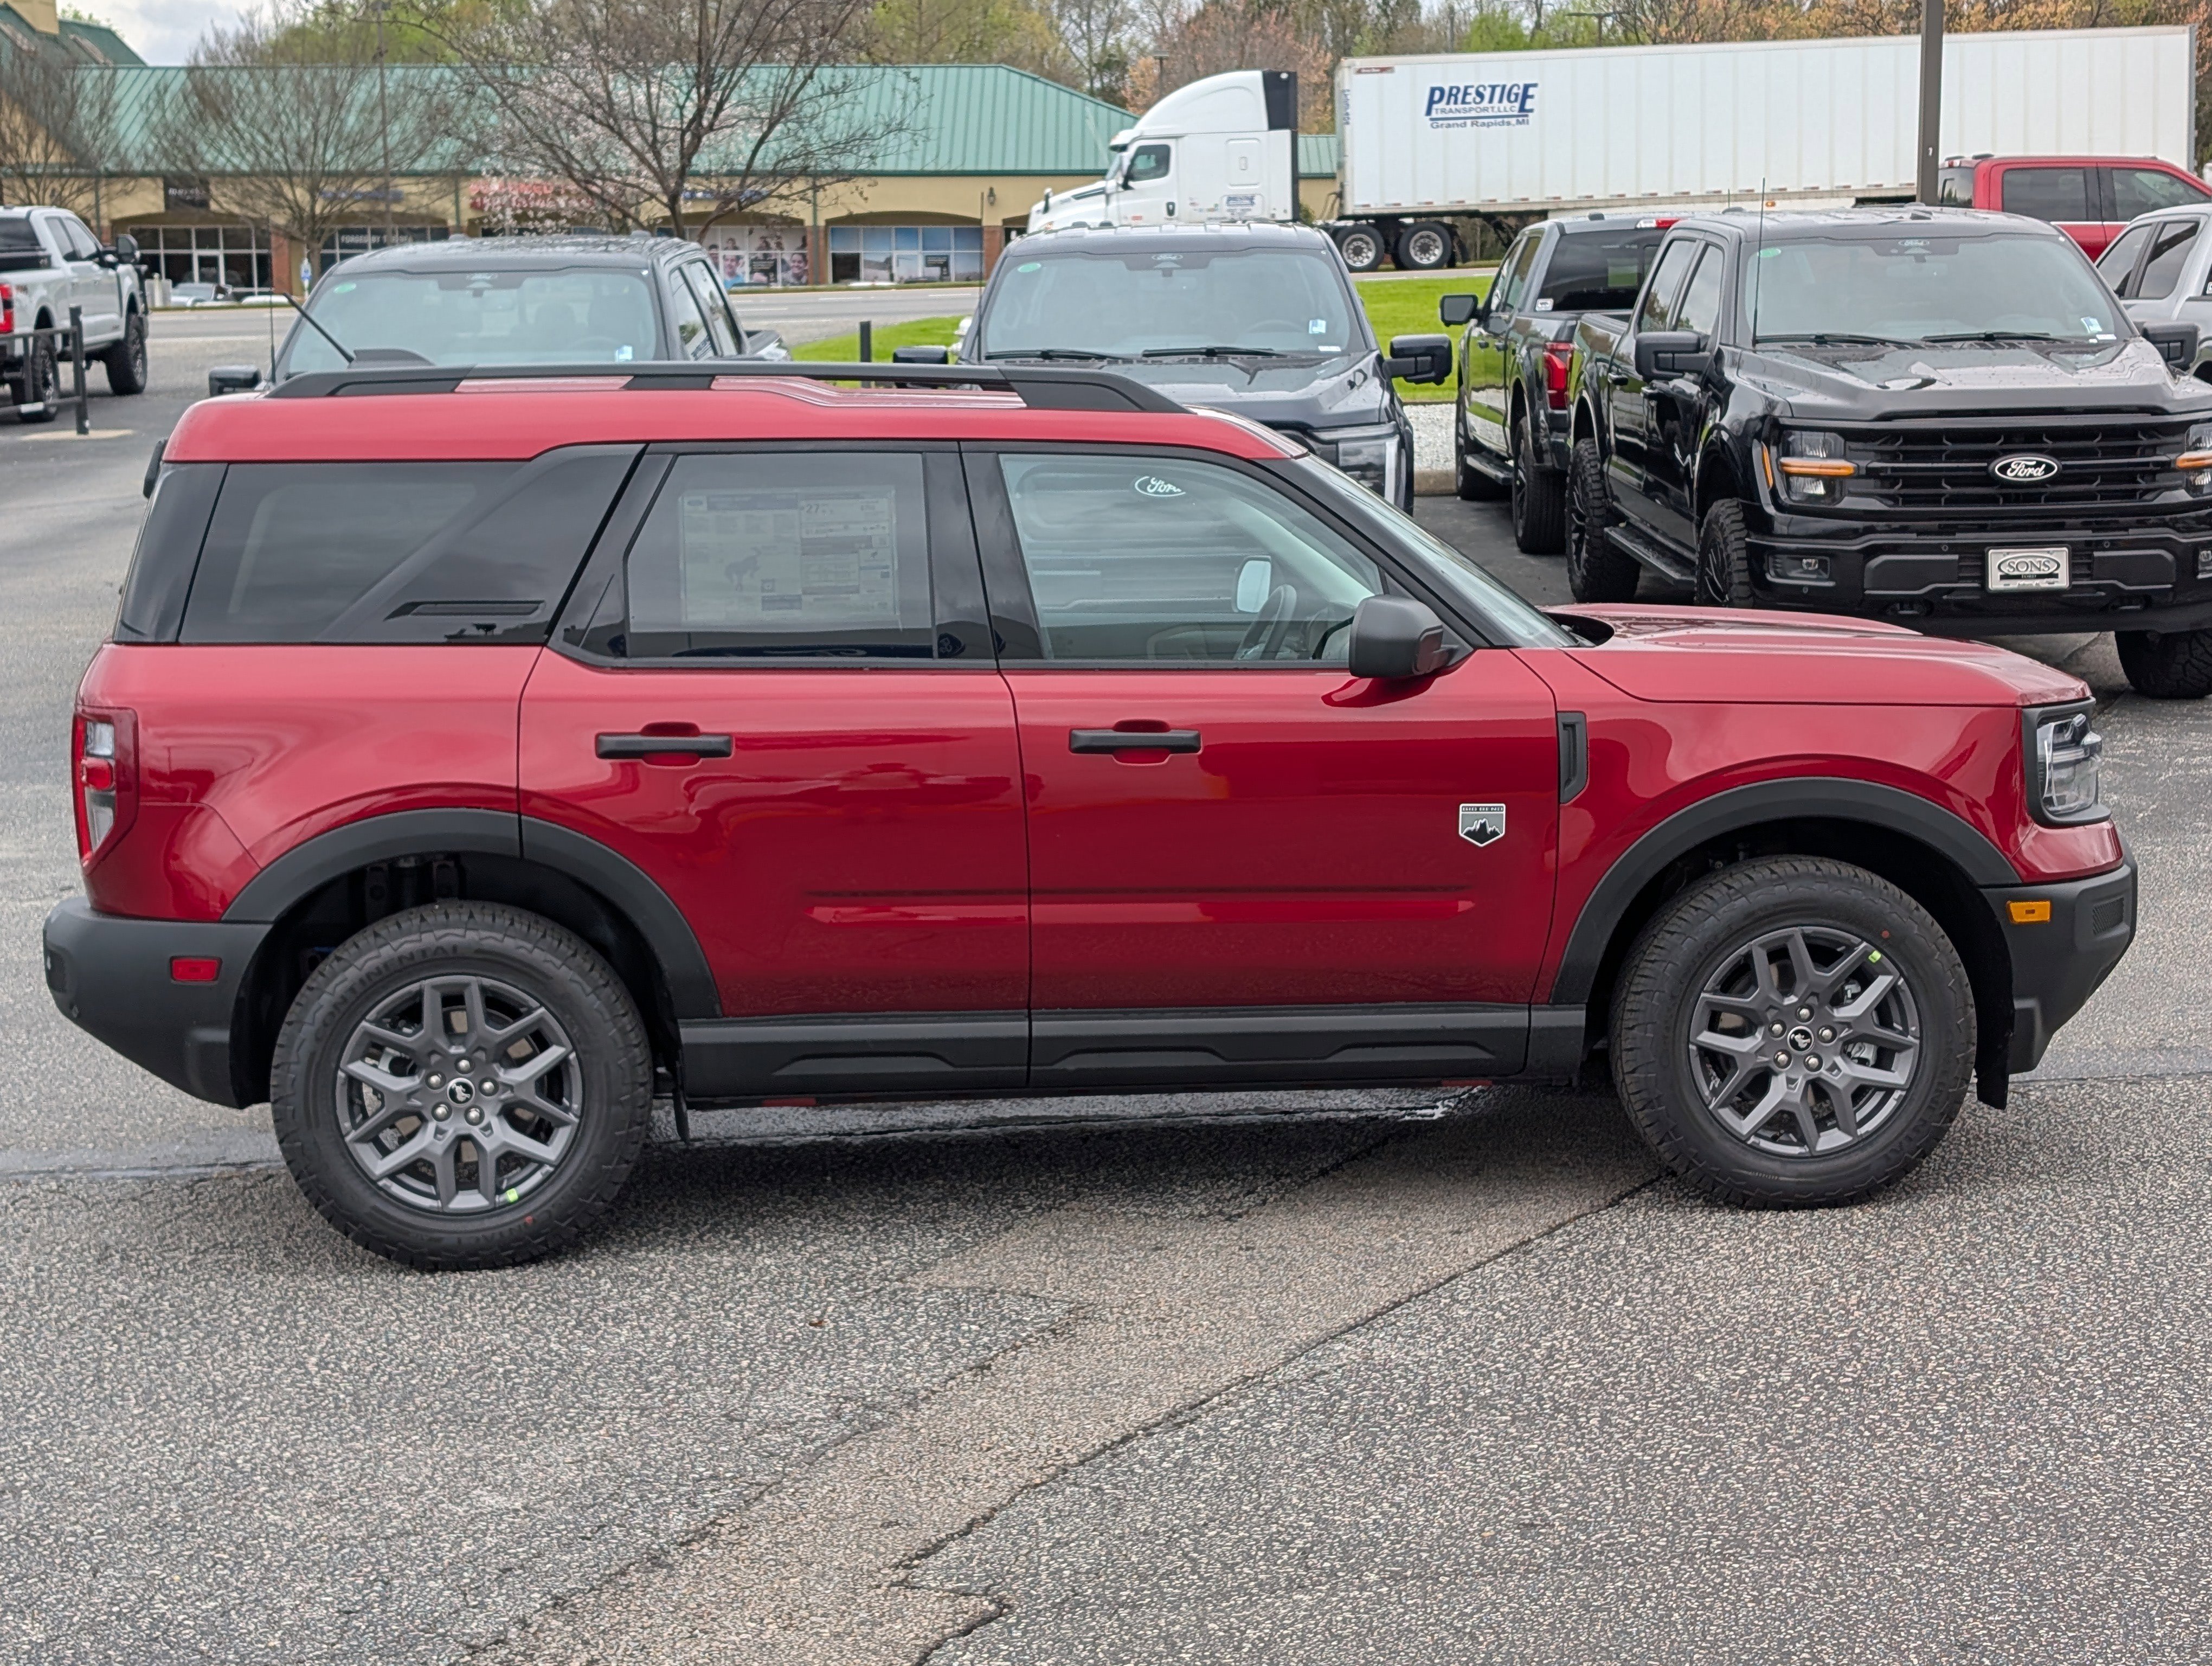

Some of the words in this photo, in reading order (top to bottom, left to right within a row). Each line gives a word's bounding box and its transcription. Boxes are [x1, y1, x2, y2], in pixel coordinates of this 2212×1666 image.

[1425, 83, 1539, 116] PRESTIGE
[2007, 460, 2046, 477] Ford
[2007, 559, 2050, 573] SONS
